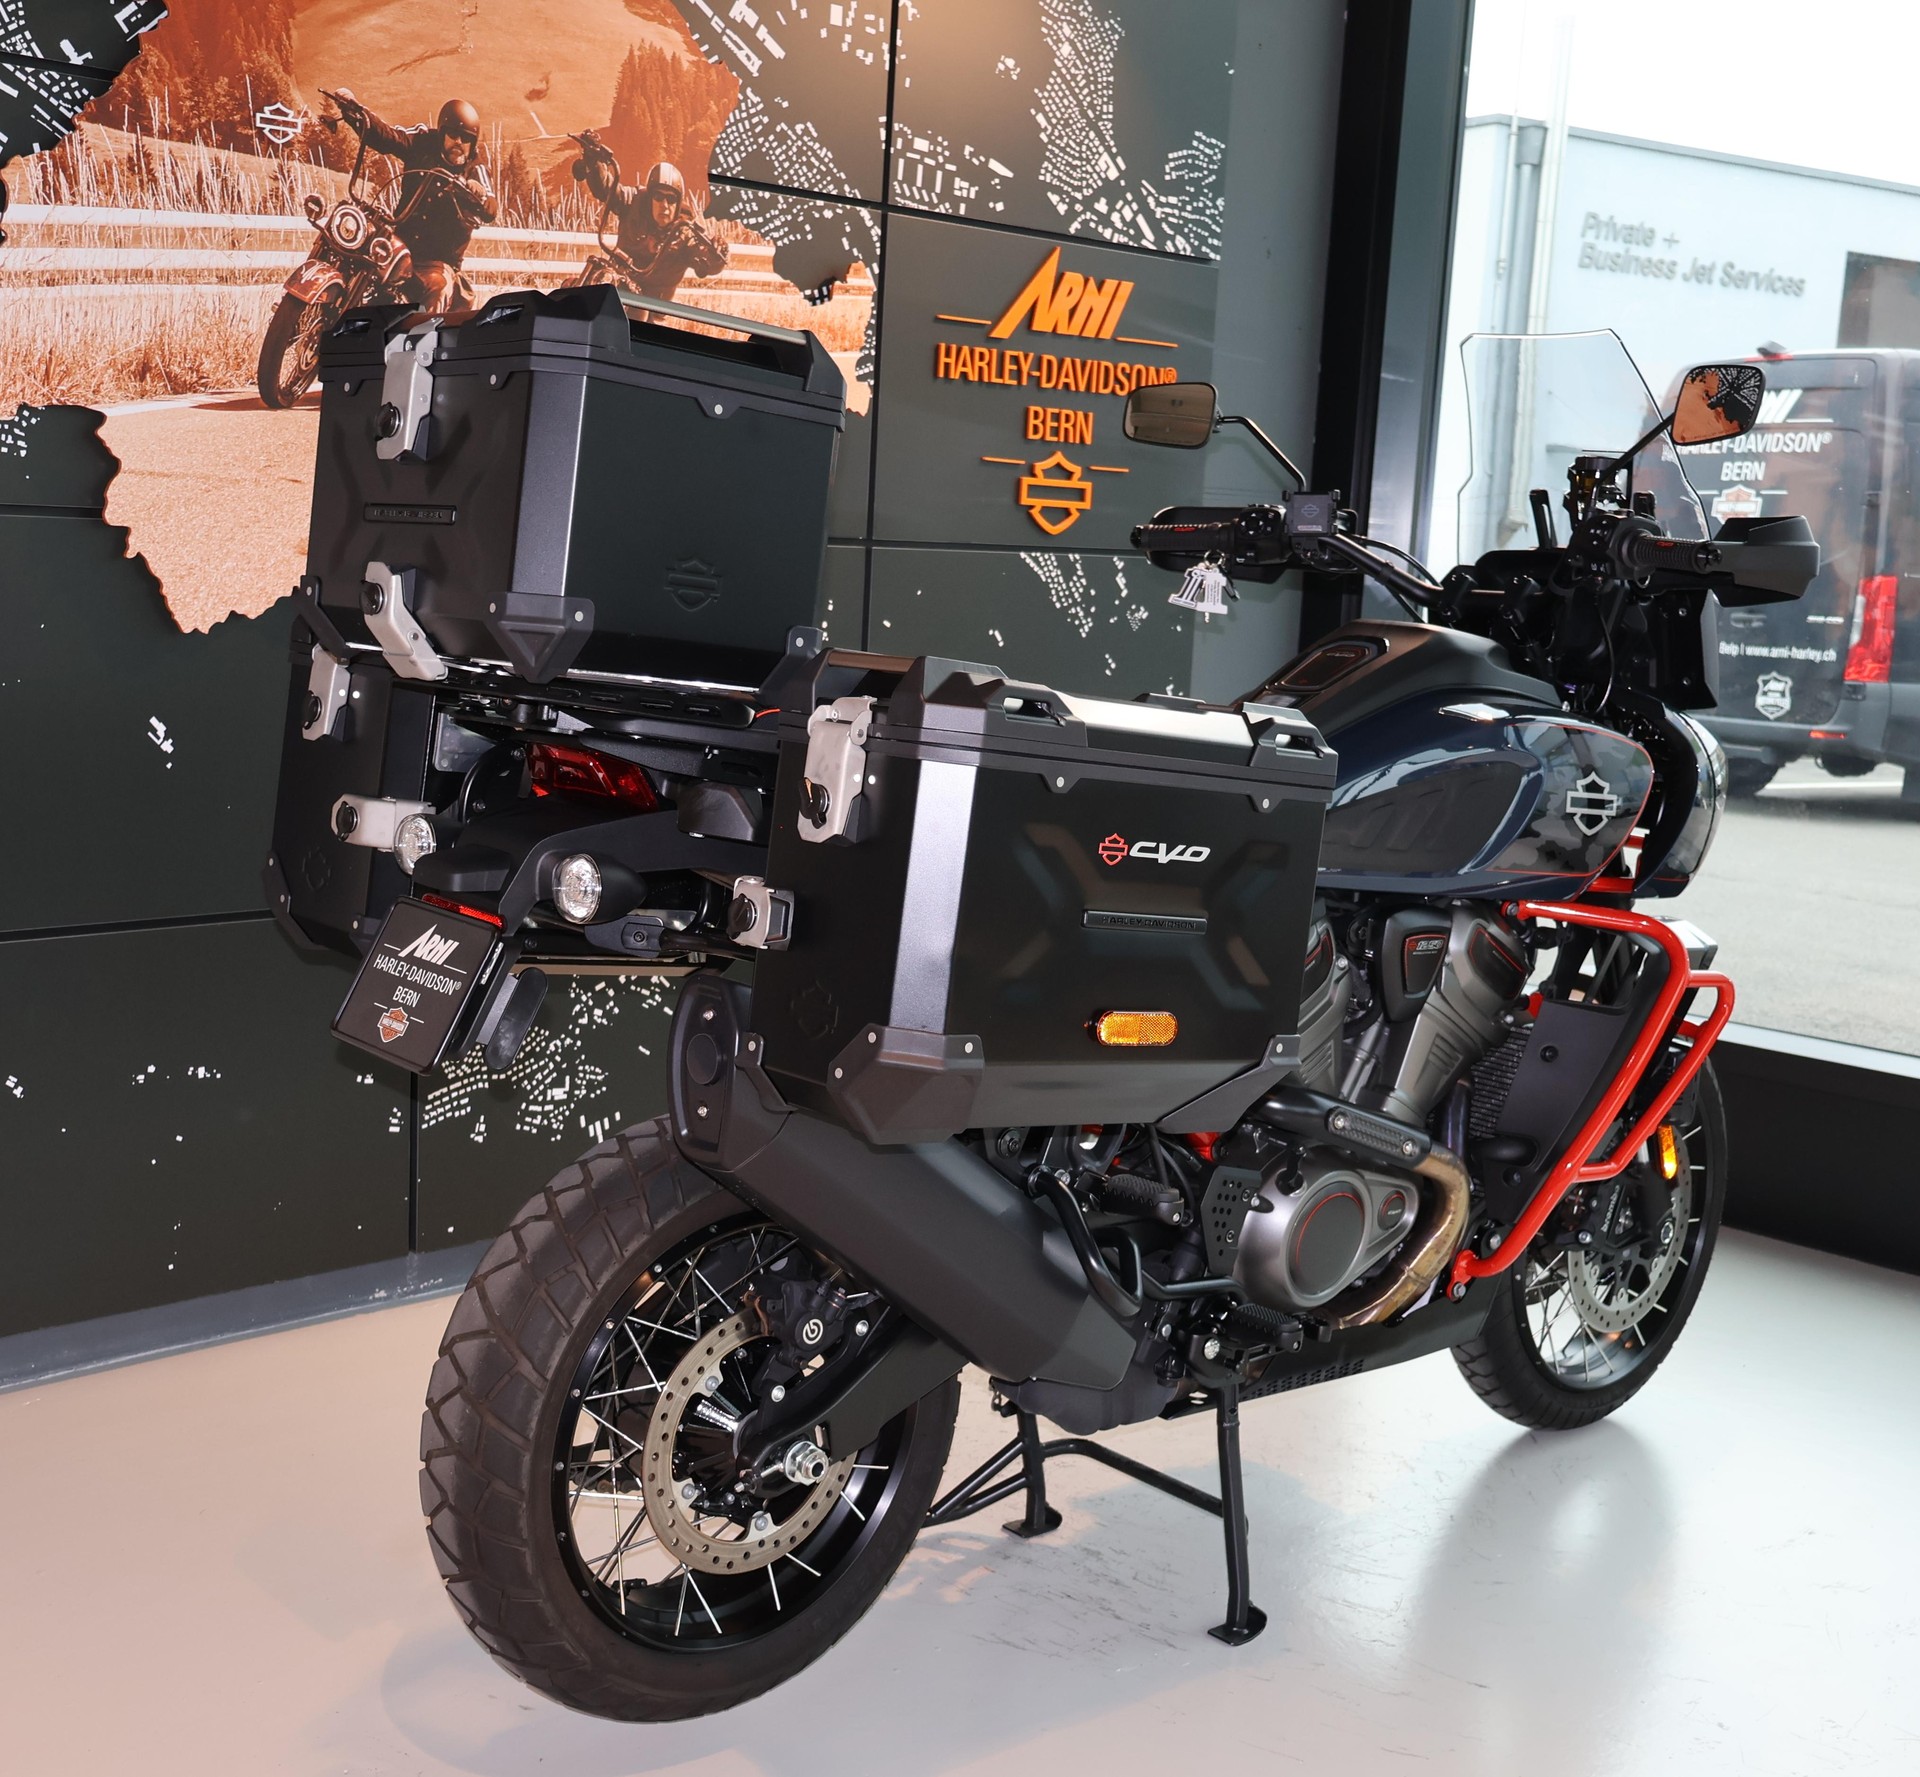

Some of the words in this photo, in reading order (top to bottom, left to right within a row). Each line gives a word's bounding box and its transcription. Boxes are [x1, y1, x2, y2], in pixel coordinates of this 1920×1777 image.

[1580, 211, 1656, 248] Private
[1662, 232, 1681, 248] +
[1578, 241, 1678, 281] Business
[1682, 256, 1717, 286] Jet
[1719, 260, 1807, 297] Services
[987, 245, 1135, 339] ARNI
[1025, 405, 1094, 445] BERN
[1720, 461, 1766, 482] BERN
[1129, 841, 1211, 864] CVO
[398, 923, 460, 965] ARNI
[393, 985, 421, 1008] BERN
